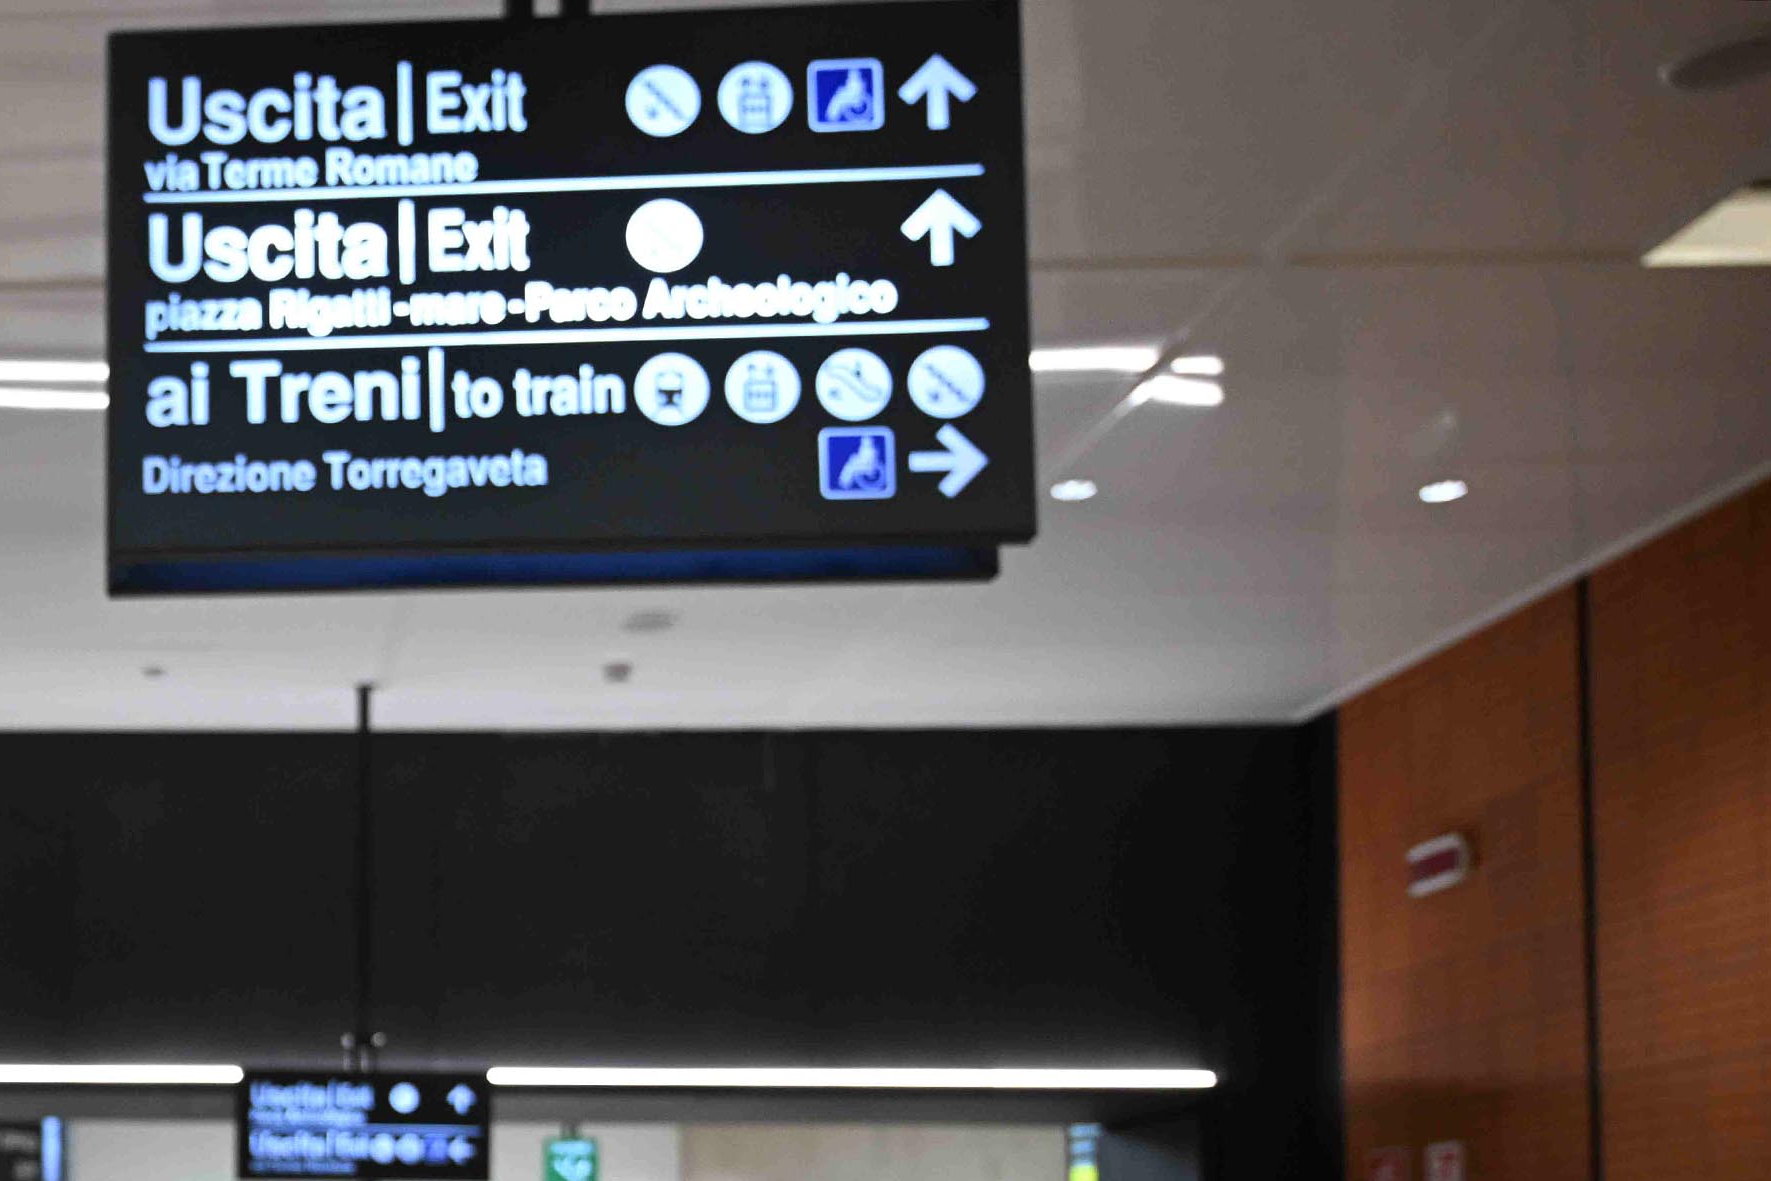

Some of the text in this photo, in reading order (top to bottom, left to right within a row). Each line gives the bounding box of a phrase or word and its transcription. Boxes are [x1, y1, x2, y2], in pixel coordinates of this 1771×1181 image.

[147, 68, 528, 147] Uscita Exit
[144, 146, 479, 192] via Terme Romane
[147, 204, 530, 284] Uscita Exit
[144, 291, 263, 341] piazza
[145, 355, 626, 428] ai Treni to train
[142, 447, 548, 497] Direzione Torregaveta
